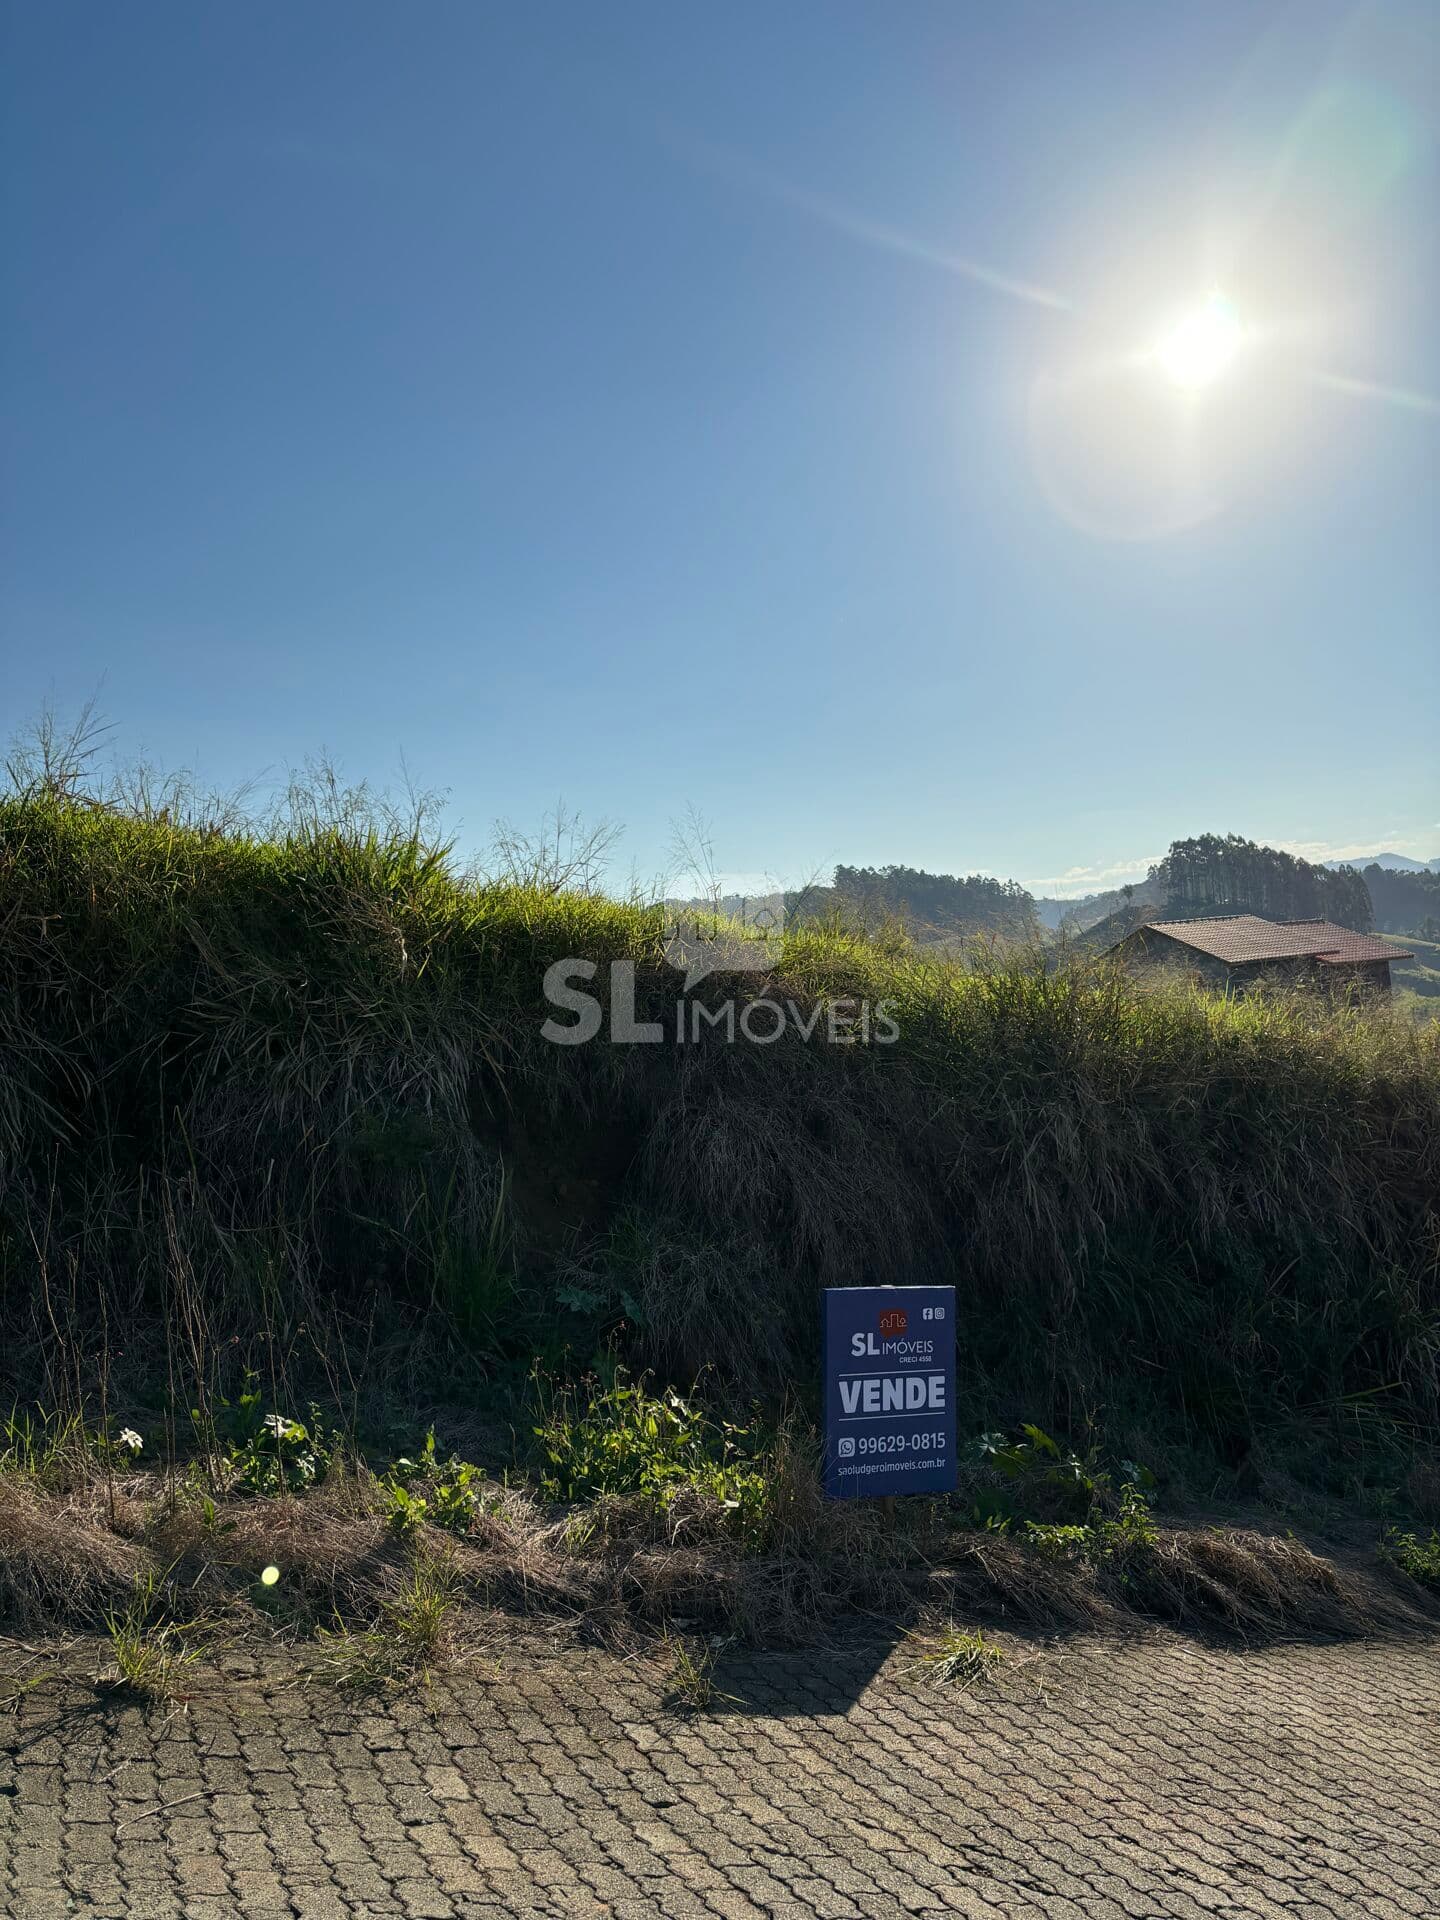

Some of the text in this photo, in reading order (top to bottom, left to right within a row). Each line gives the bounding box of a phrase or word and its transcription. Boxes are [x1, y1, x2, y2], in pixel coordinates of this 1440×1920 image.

[851, 1332, 934, 1357] SL IMÓVEIS
[838, 1375, 946, 1414] VENDE
[858, 1432, 946, 1455] 99629-0815
[837, 1458, 946, 1476] saoludgeroimoveis.com.br
